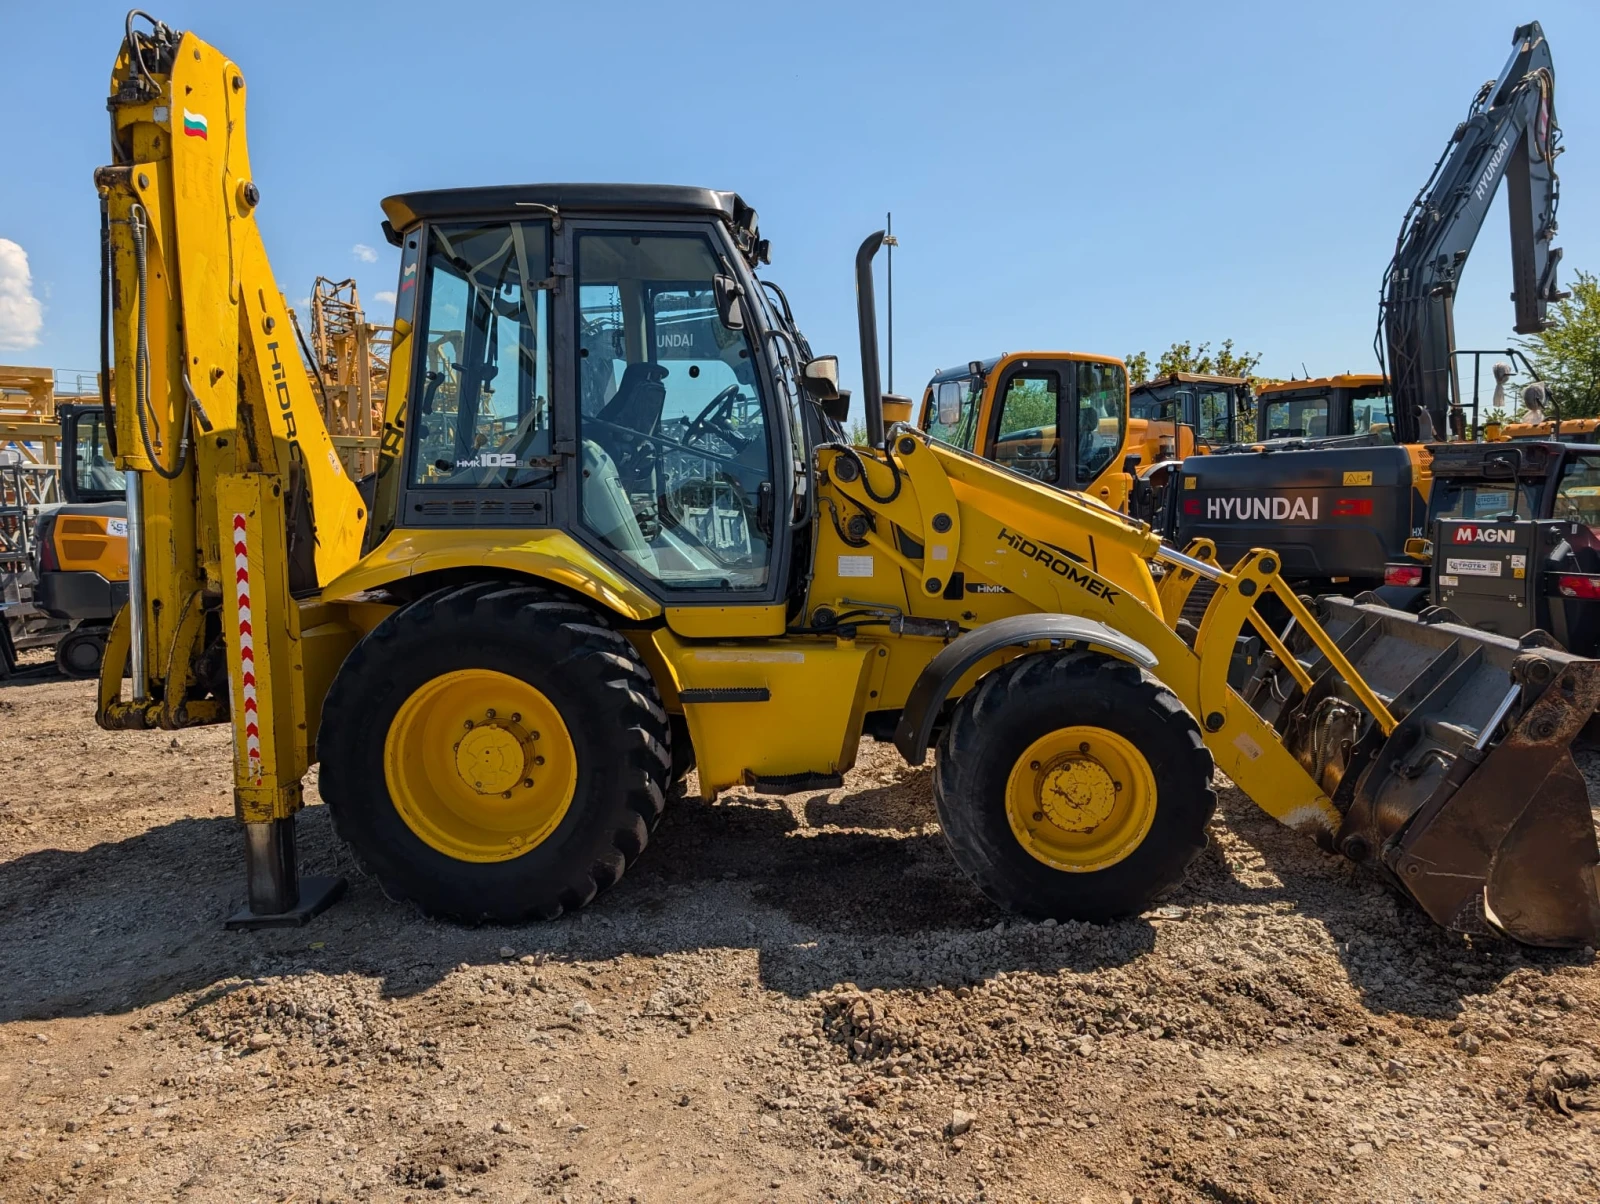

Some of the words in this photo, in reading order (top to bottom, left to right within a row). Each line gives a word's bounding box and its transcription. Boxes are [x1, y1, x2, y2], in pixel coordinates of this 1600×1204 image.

[1475, 137, 1509, 201] HYUNDAI
[656, 333, 694, 348] UNDAI
[1207, 497, 1319, 520] HYUNDAI
[1411, 526, 1423, 537] HX
[1456, 528, 1516, 543] MAGNI
[977, 584, 1005, 593] HMK
